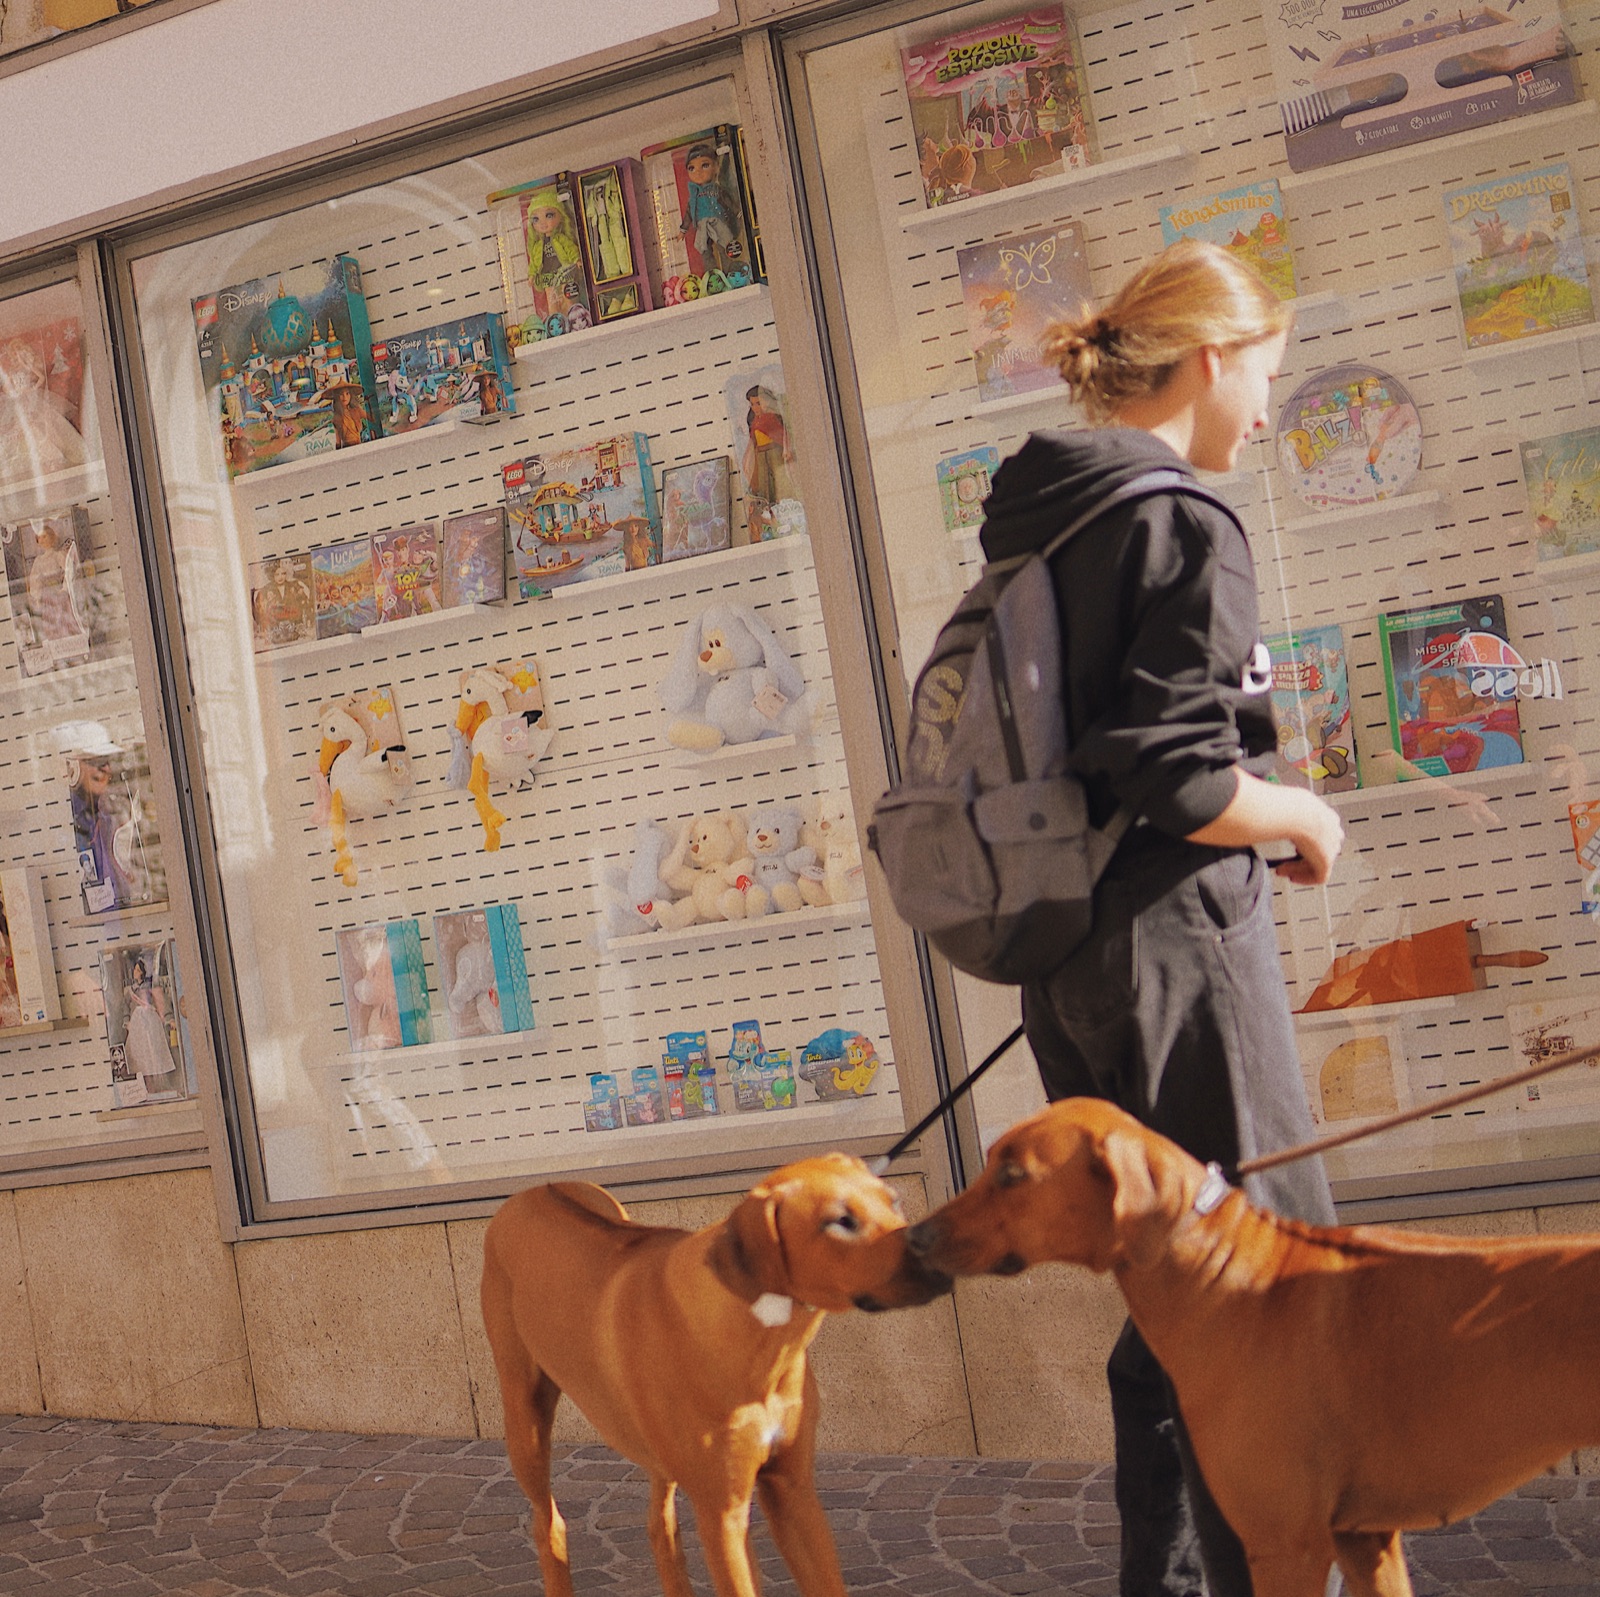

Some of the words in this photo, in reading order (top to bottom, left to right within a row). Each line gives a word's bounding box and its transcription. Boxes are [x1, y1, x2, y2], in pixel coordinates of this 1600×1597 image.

[1346, 9, 1359, 18] UNA
[947, 33, 1023, 63] POZIONI
[935, 44, 1039, 83] ESPLOSIVE
[1168, 191, 1275, 231] Kingdomino
[198, 305, 215, 319] LEGO
[374, 347, 387, 357] LEGO
[304, 437, 332, 452] RAYA
[506, 468, 523, 480] LEGO
[330, 549, 355, 570] LUCA
[598, 564, 622, 574] RAYA
[394, 571, 420, 586] TOY
[402, 590, 414, 602] 4
[1415, 638, 1477, 656] MISSIONE
[1442, 652, 1488, 668] SPAZIO
